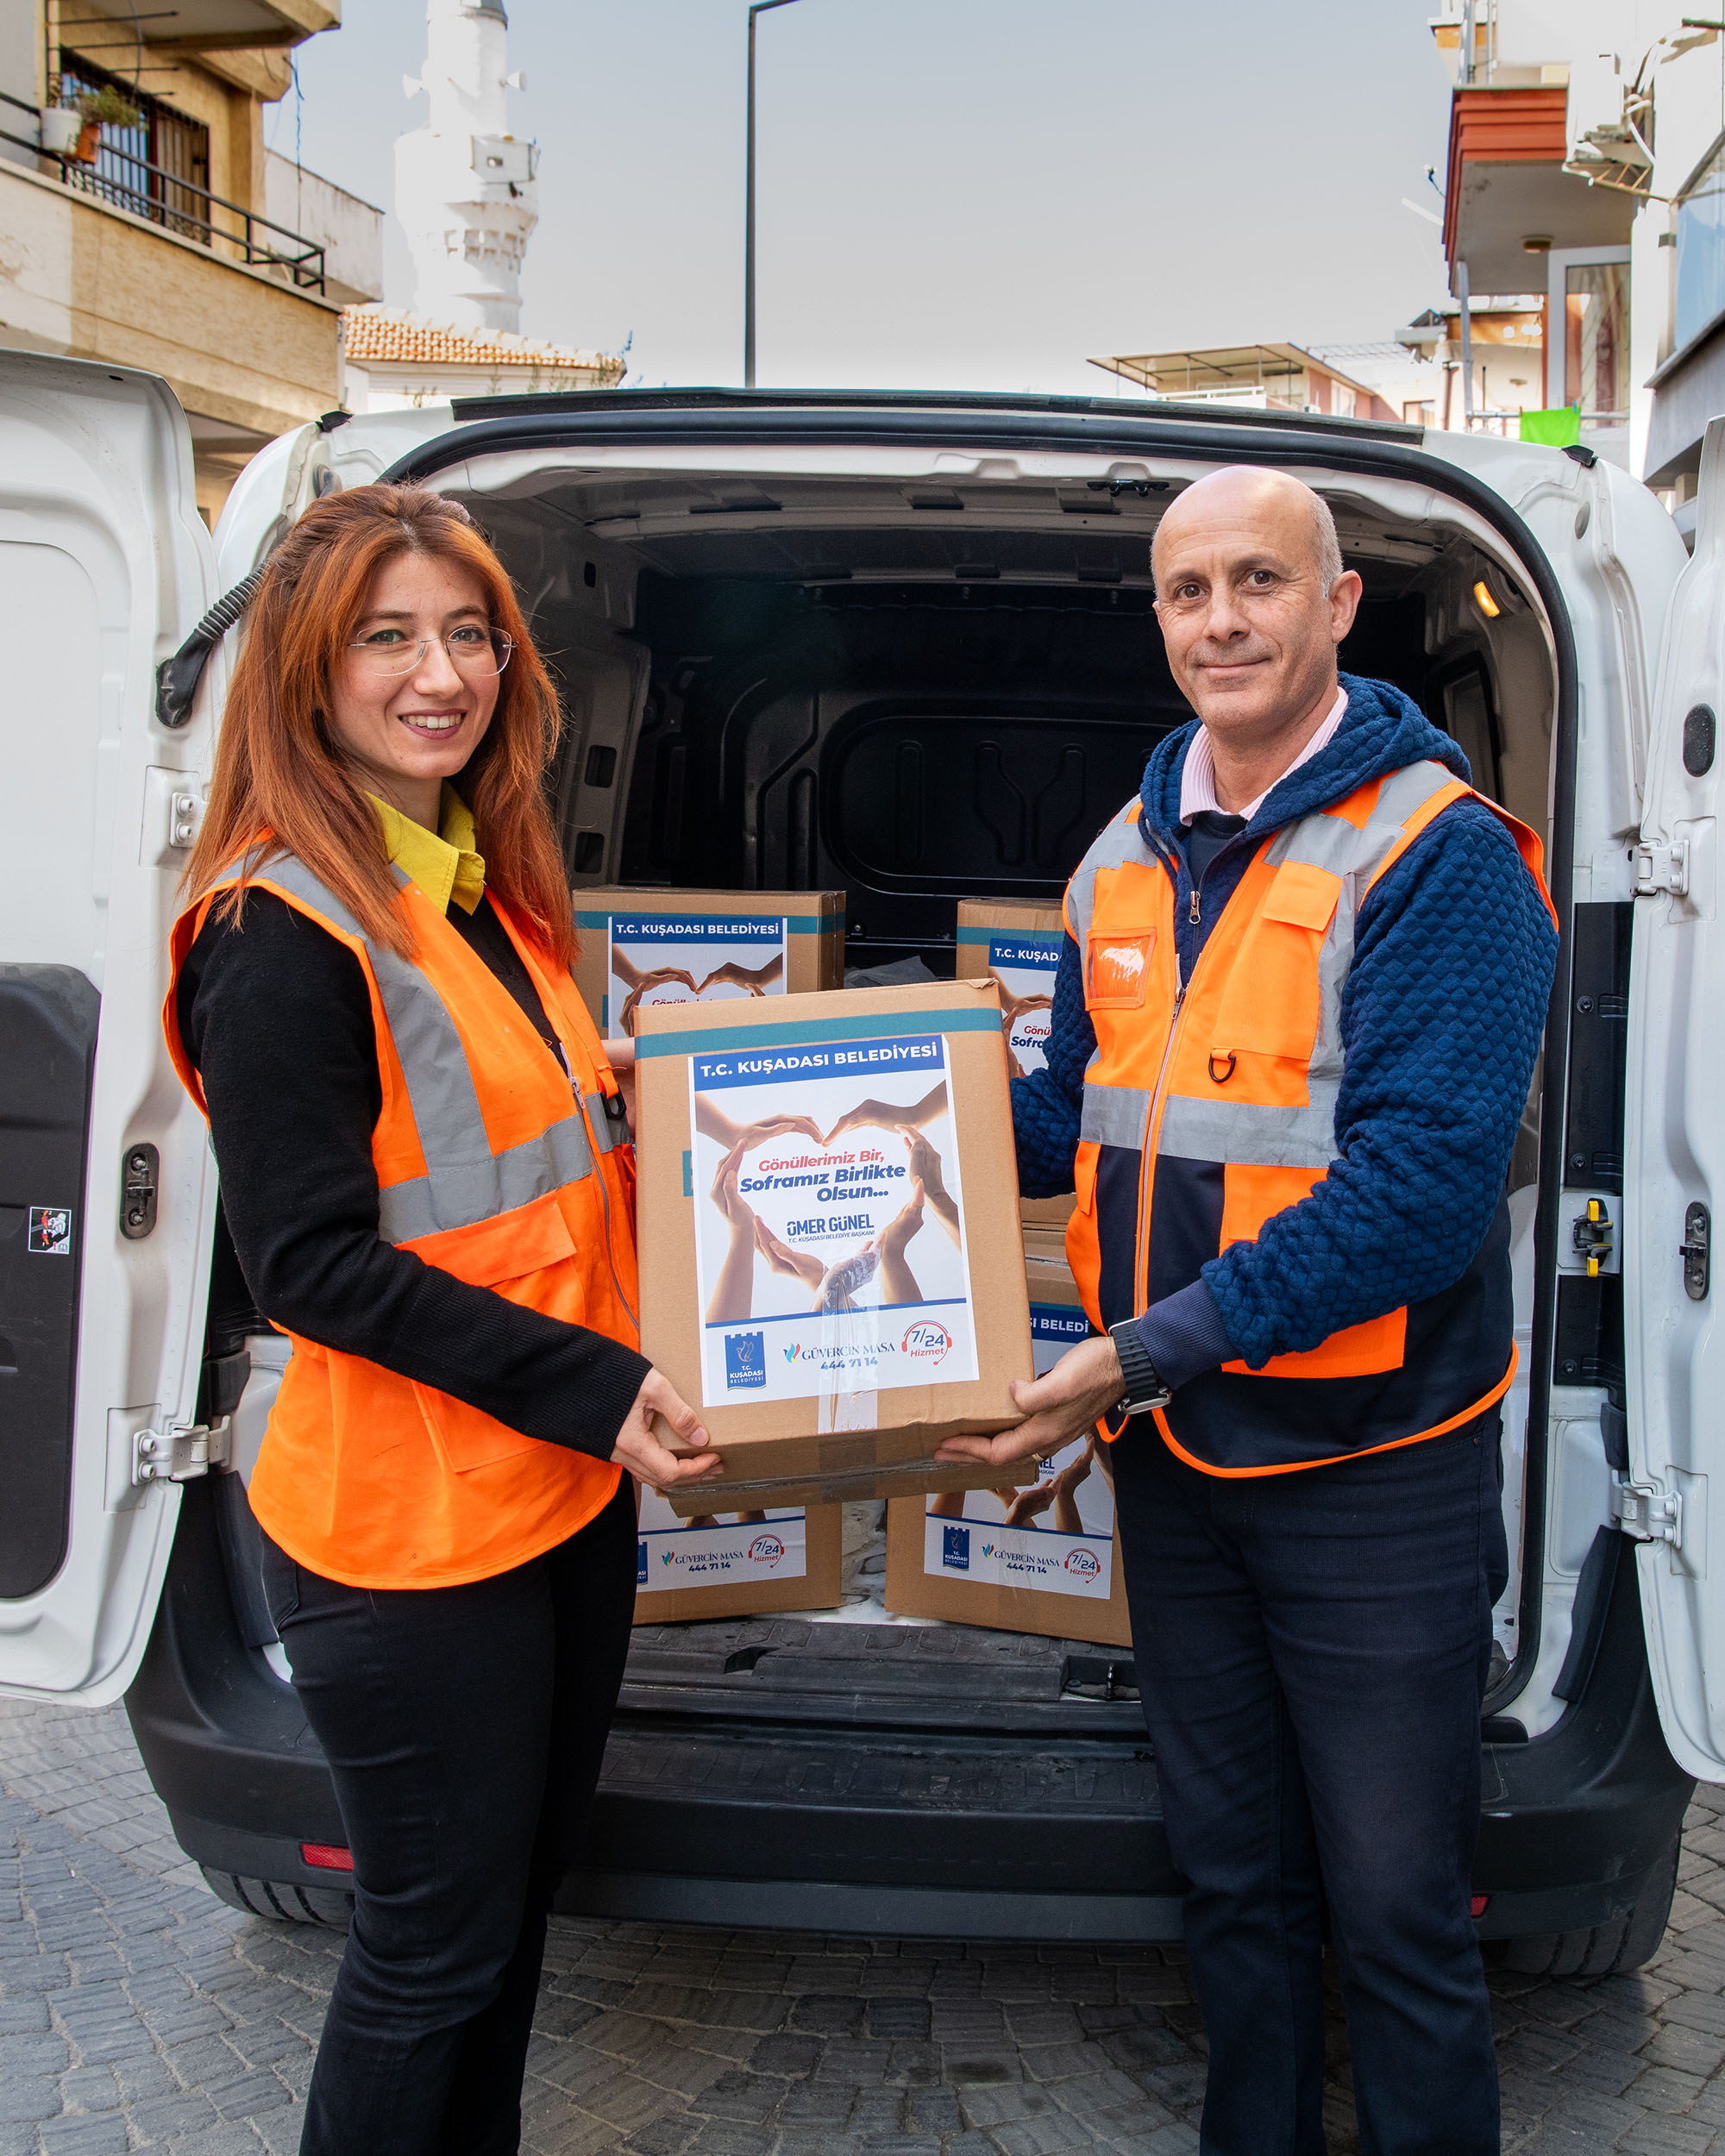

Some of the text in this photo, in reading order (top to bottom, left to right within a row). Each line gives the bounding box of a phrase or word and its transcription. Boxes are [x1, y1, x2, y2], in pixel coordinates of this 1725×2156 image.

[616, 923, 779, 936] T.C. KUŞADASI BELEDİYESİ
[994, 948, 1061, 962] T.C. KUŞAD
[700, 1042, 938, 1077] T.C. KUŞADASI BELEDİYESİ
[758, 1149, 884, 1172] Gönüllerimiz Bir,
[740, 1164, 906, 1193] Soframız Birlikte
[817, 1186, 888, 1202] Olsun...
[828, 1213, 875, 1232] GÜNEL
[912, 1328, 944, 1347] 7/24
[801, 1342, 894, 1360] GÜVERCİN MASA
[911, 1348, 944, 1357] Hizmet
[821, 1360, 846, 1369] 444
[864, 1357, 878, 1366] 14
[756, 1540, 780, 1555] 7/24
[675, 1551, 743, 1564] GÜVERCİN MASA
[994, 1551, 1060, 1566] GÜVERCİN MASA
[1072, 1554, 1095, 1570] 7/24
